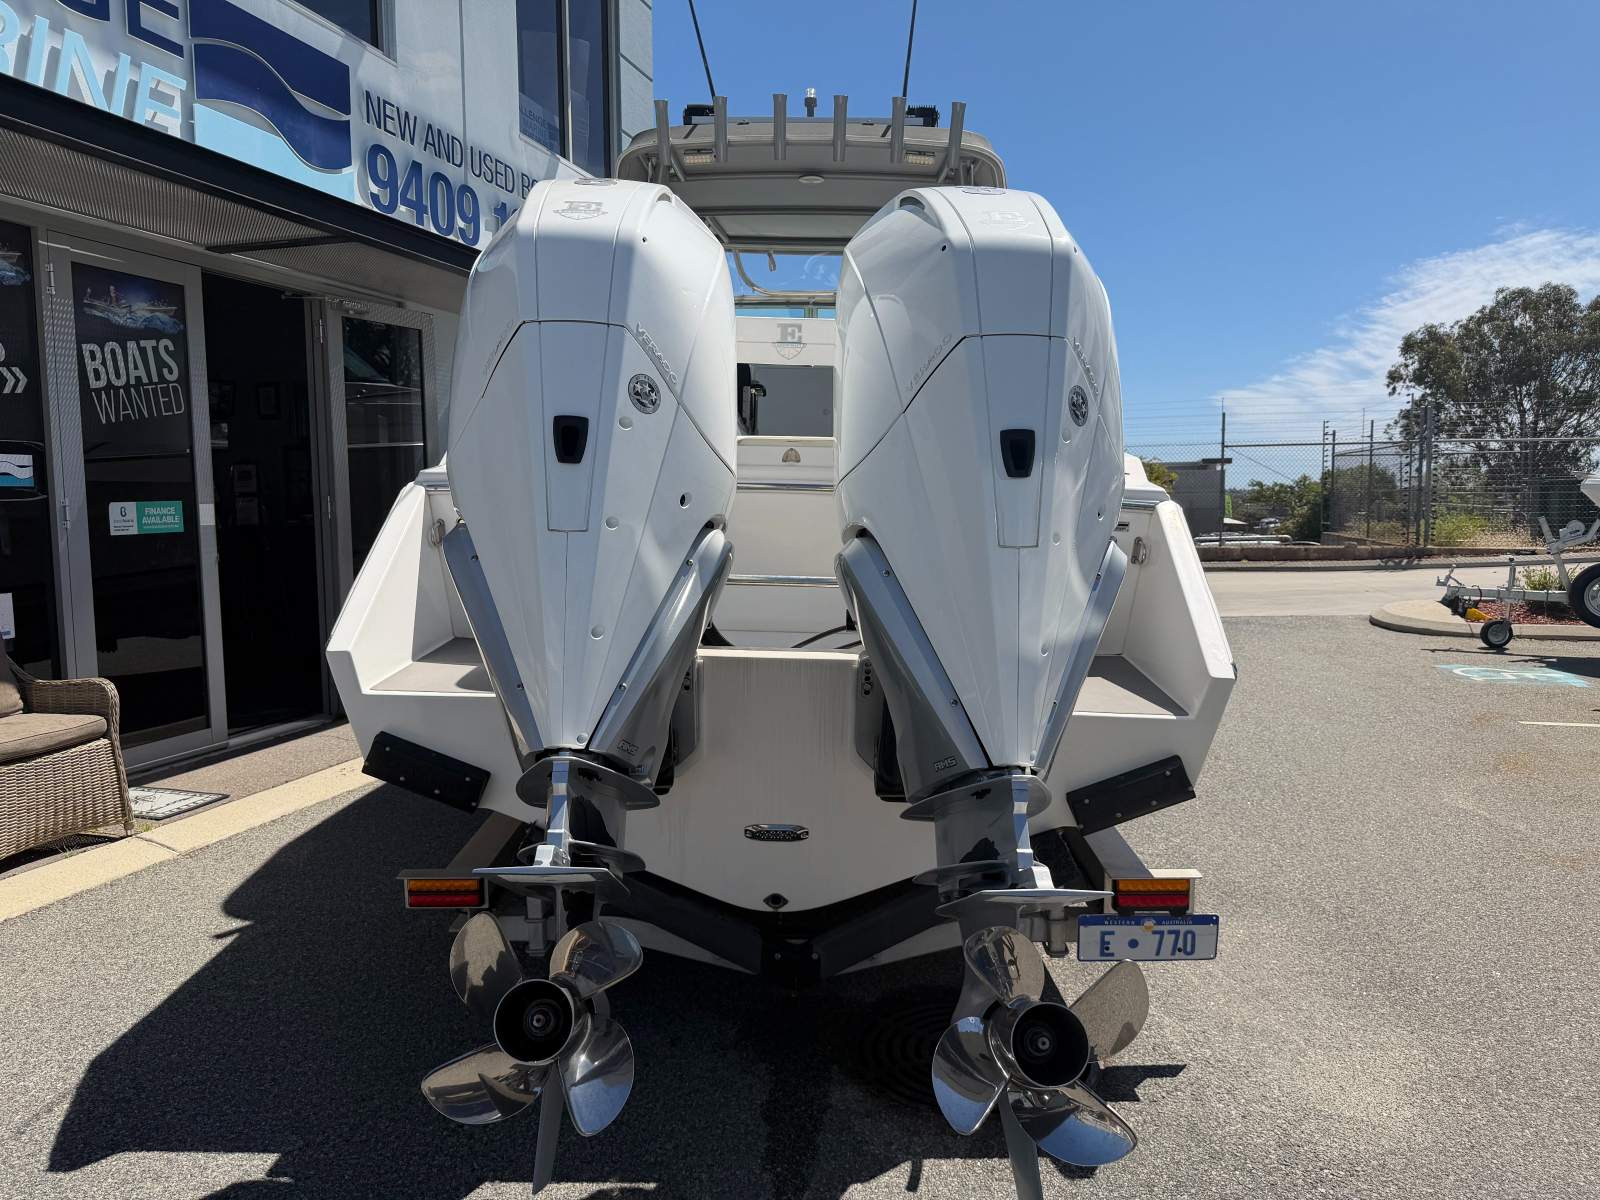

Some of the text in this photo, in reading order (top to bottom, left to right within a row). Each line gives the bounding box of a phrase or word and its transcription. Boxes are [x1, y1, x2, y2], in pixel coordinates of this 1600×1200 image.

[364, 90, 418, 147] NEW
[423, 123, 465, 169] AND
[470, 146, 516, 195] USED
[367, 143, 481, 247] 9409
[82, 338, 179, 389] BOATS
[91, 382, 185, 425] WANTED
[142, 515, 180, 524] AVAILABLE
[144, 507, 176, 515] FINANCE
[1100, 930, 1197, 957] E 770
